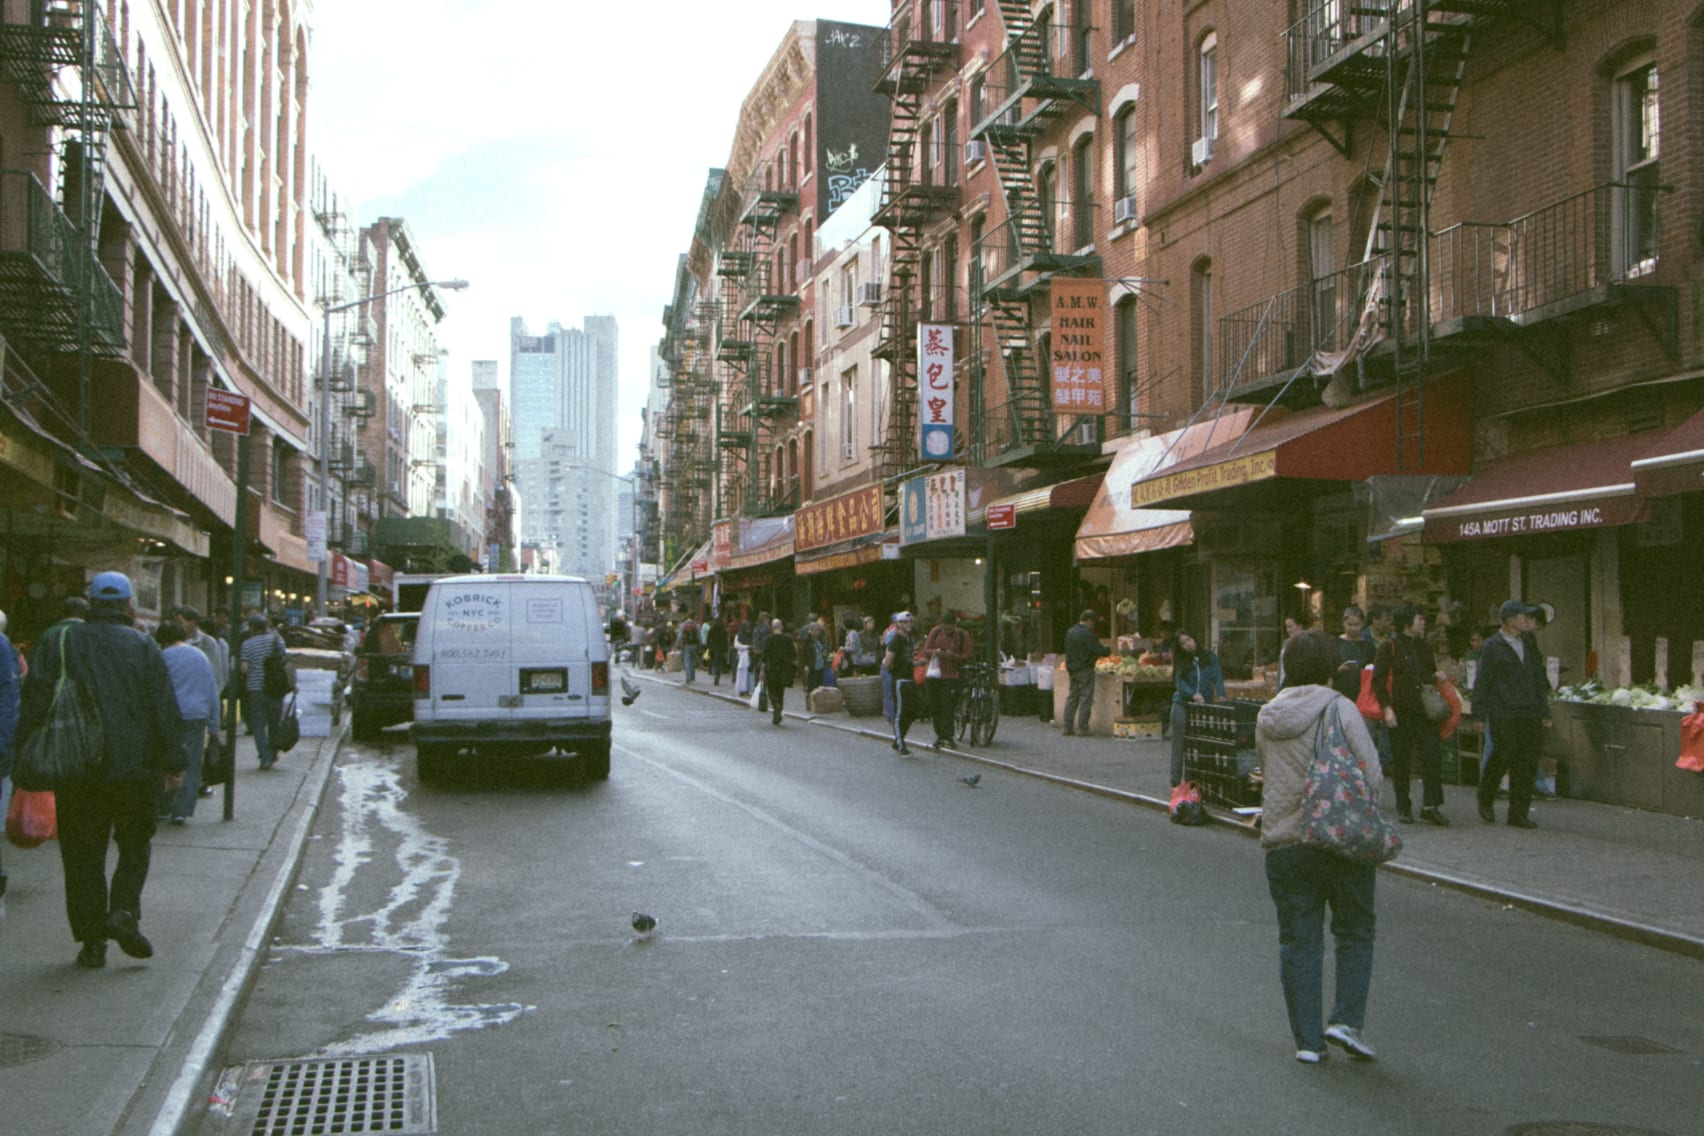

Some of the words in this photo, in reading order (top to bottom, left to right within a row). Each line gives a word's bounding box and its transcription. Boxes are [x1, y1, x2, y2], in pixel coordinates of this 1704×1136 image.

[1059, 317, 1096, 329] HAIR
[1060, 334, 1094, 346] NAIL
[1054, 350, 1101, 362] SALON
[1459, 522, 1481, 536] 145A
[1483, 518, 1510, 534] MOTT
[1530, 511, 1577, 529] TRADING
[1580, 508, 1602, 524] INC.
[445, 593, 503, 609] KOBRICK
[462, 609, 484, 617] NYC
